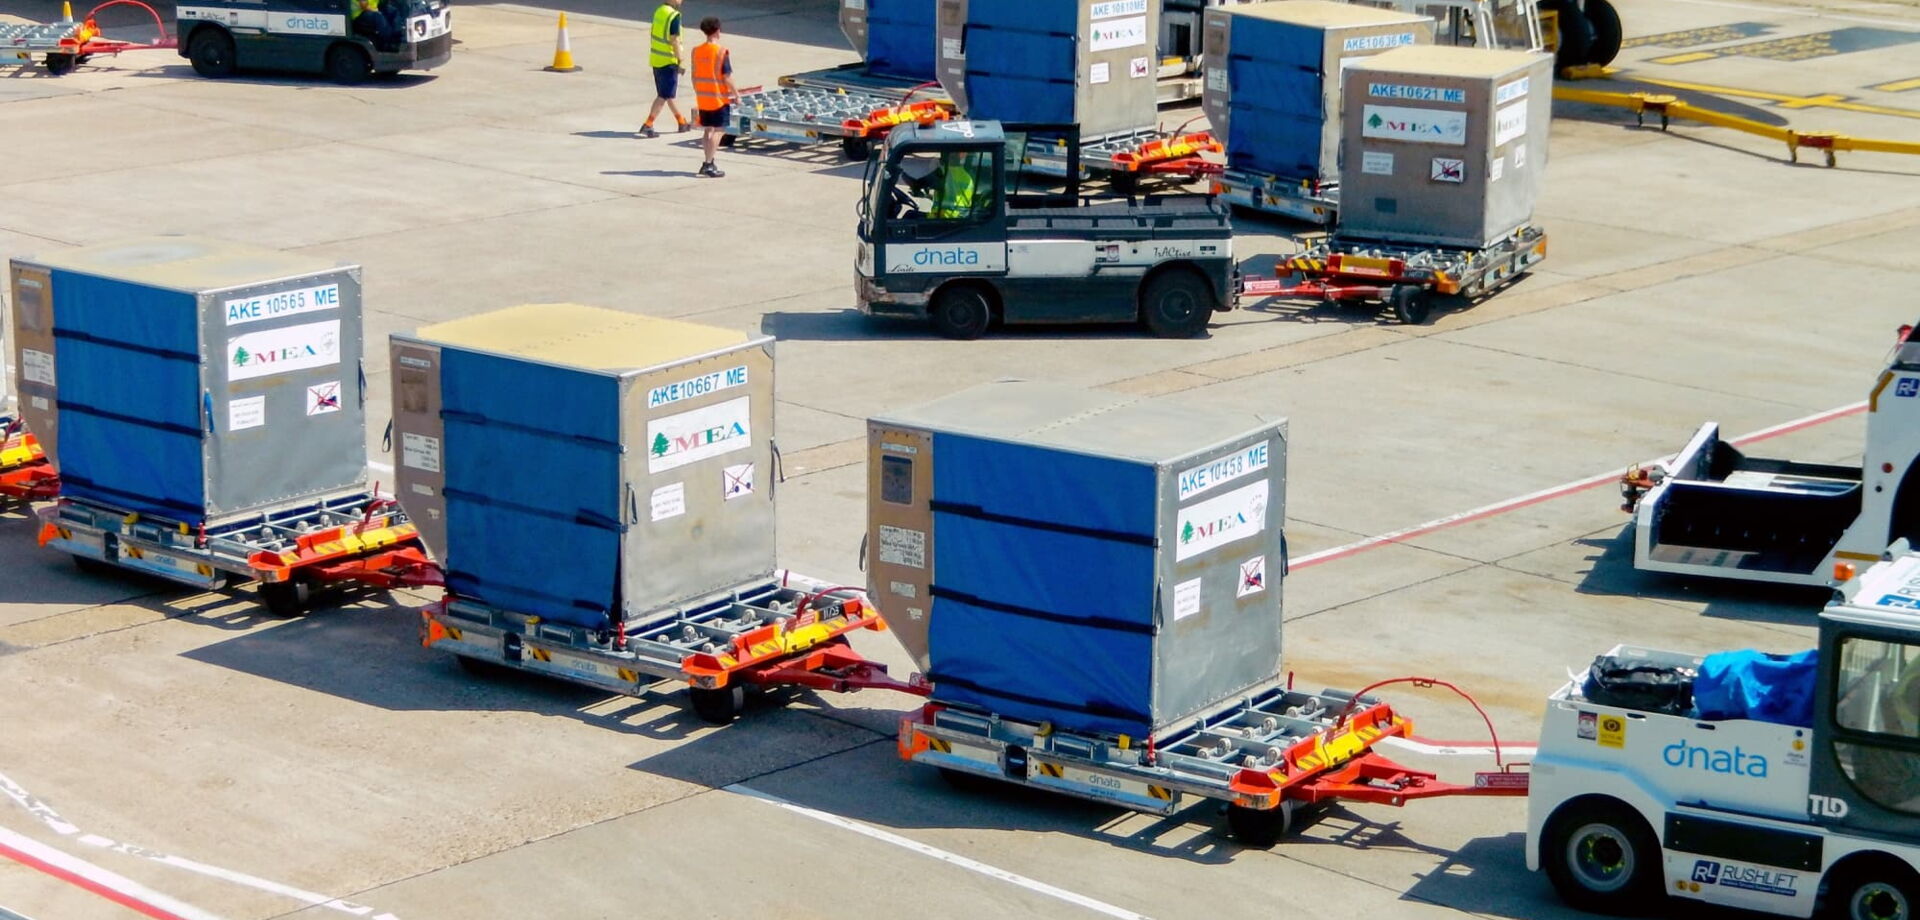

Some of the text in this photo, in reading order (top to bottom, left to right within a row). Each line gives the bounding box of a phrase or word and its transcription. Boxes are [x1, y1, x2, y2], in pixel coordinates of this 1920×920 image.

[286, 17, 329, 31] dnata
[1399, 32, 1413, 45] ME
[1443, 90, 1463, 102] ME
[1386, 120, 1442, 135] MEA
[913, 247, 978, 265] dnata
[228, 288, 337, 321] AKE 10565 ME
[255, 345, 317, 363] MEA
[726, 367, 746, 386] ME
[1898, 379, 1918, 396] RL
[672, 422, 748, 452] MEA
[1180, 445, 1267, 496] AKE 10458 ME
[1196, 511, 1247, 540] MEA
[1662, 739, 1768, 778] dnata
[1088, 774, 1121, 789] dnata
[1809, 794, 1849, 819] TLD
[1694, 863, 1717, 881] RL
[1721, 864, 1798, 889] RUSHLIFT
